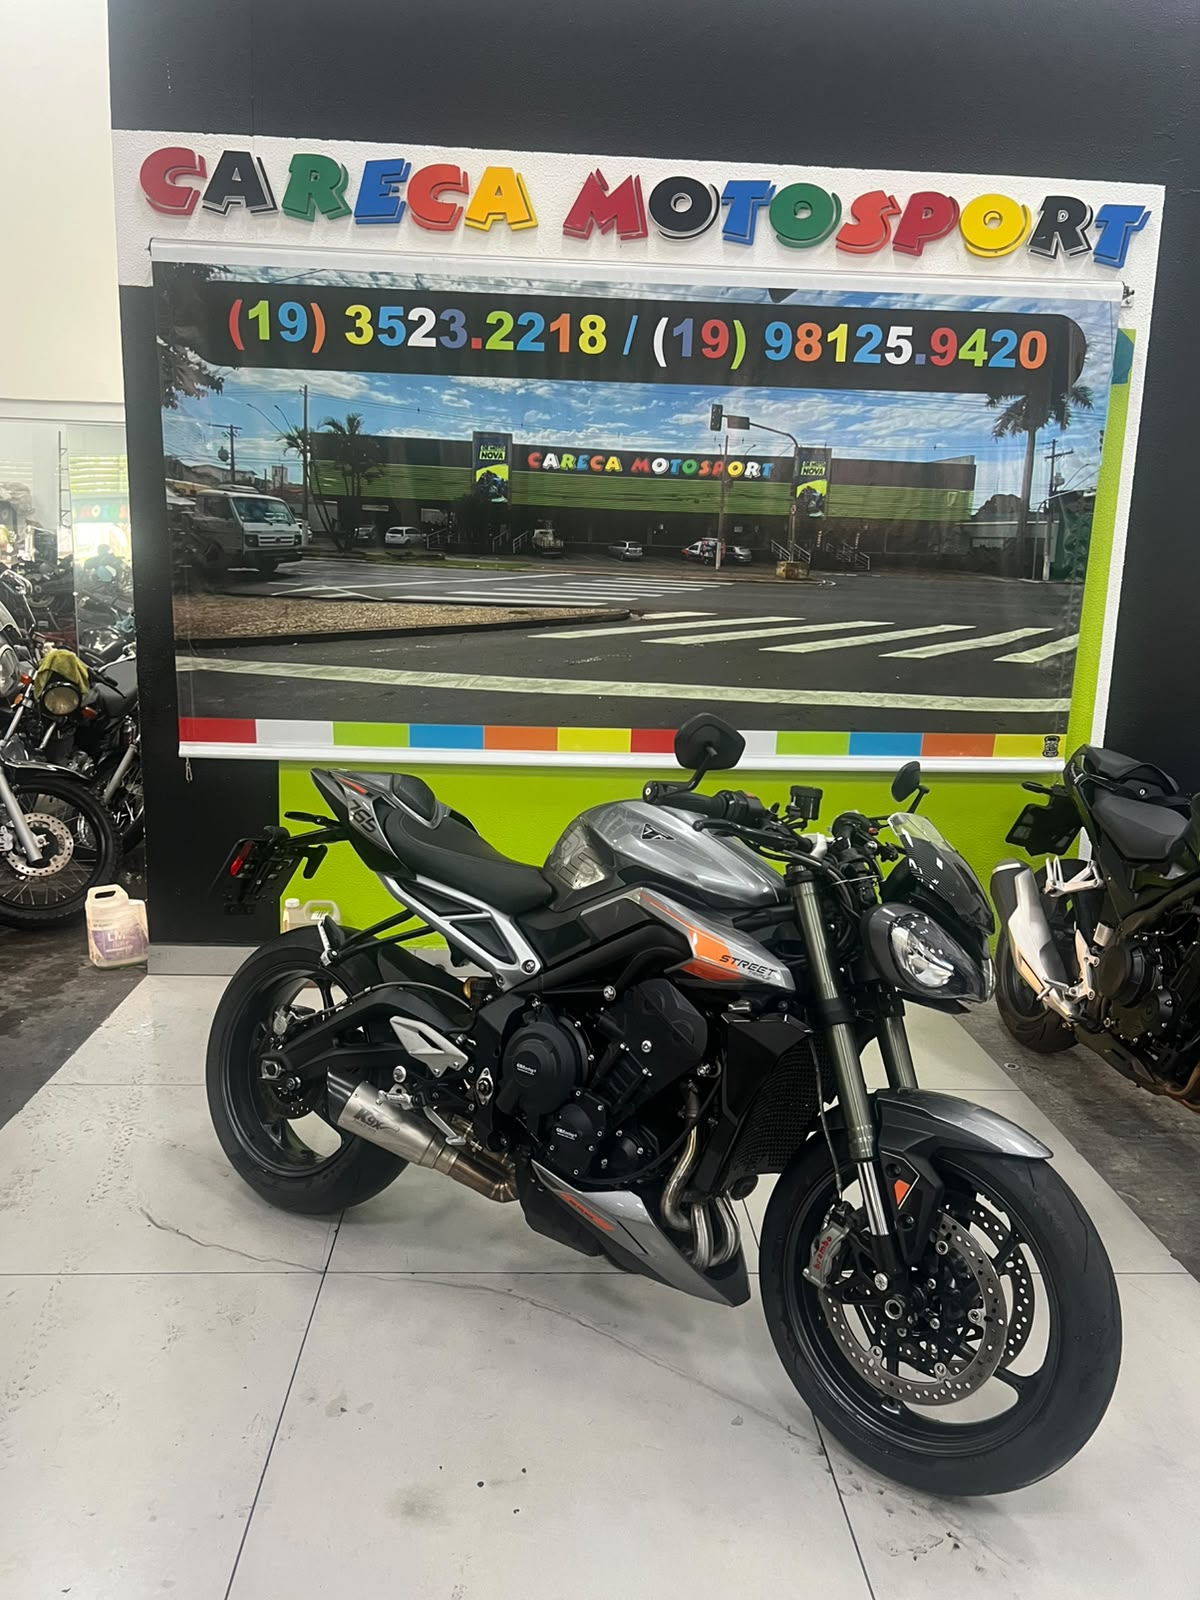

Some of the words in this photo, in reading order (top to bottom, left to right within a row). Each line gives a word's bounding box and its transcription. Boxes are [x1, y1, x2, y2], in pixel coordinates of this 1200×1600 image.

[139, 146, 538, 232] CARECA
[563, 167, 1151, 268] MOTOSPORT
[228, 299, 326, 353] (19)
[345, 303, 607, 355] 3523.2218
[623, 315, 638, 355] /
[653, 317, 747, 370] (19)
[765, 320, 1047, 370] 98125.9420
[527, 453, 622, 473] CARECA
[631, 457, 774, 479] MOTOSPORT
[349, 799, 377, 833] 765
[719, 954, 777, 977] STREET
[813, 1236, 832, 1270] brembo
